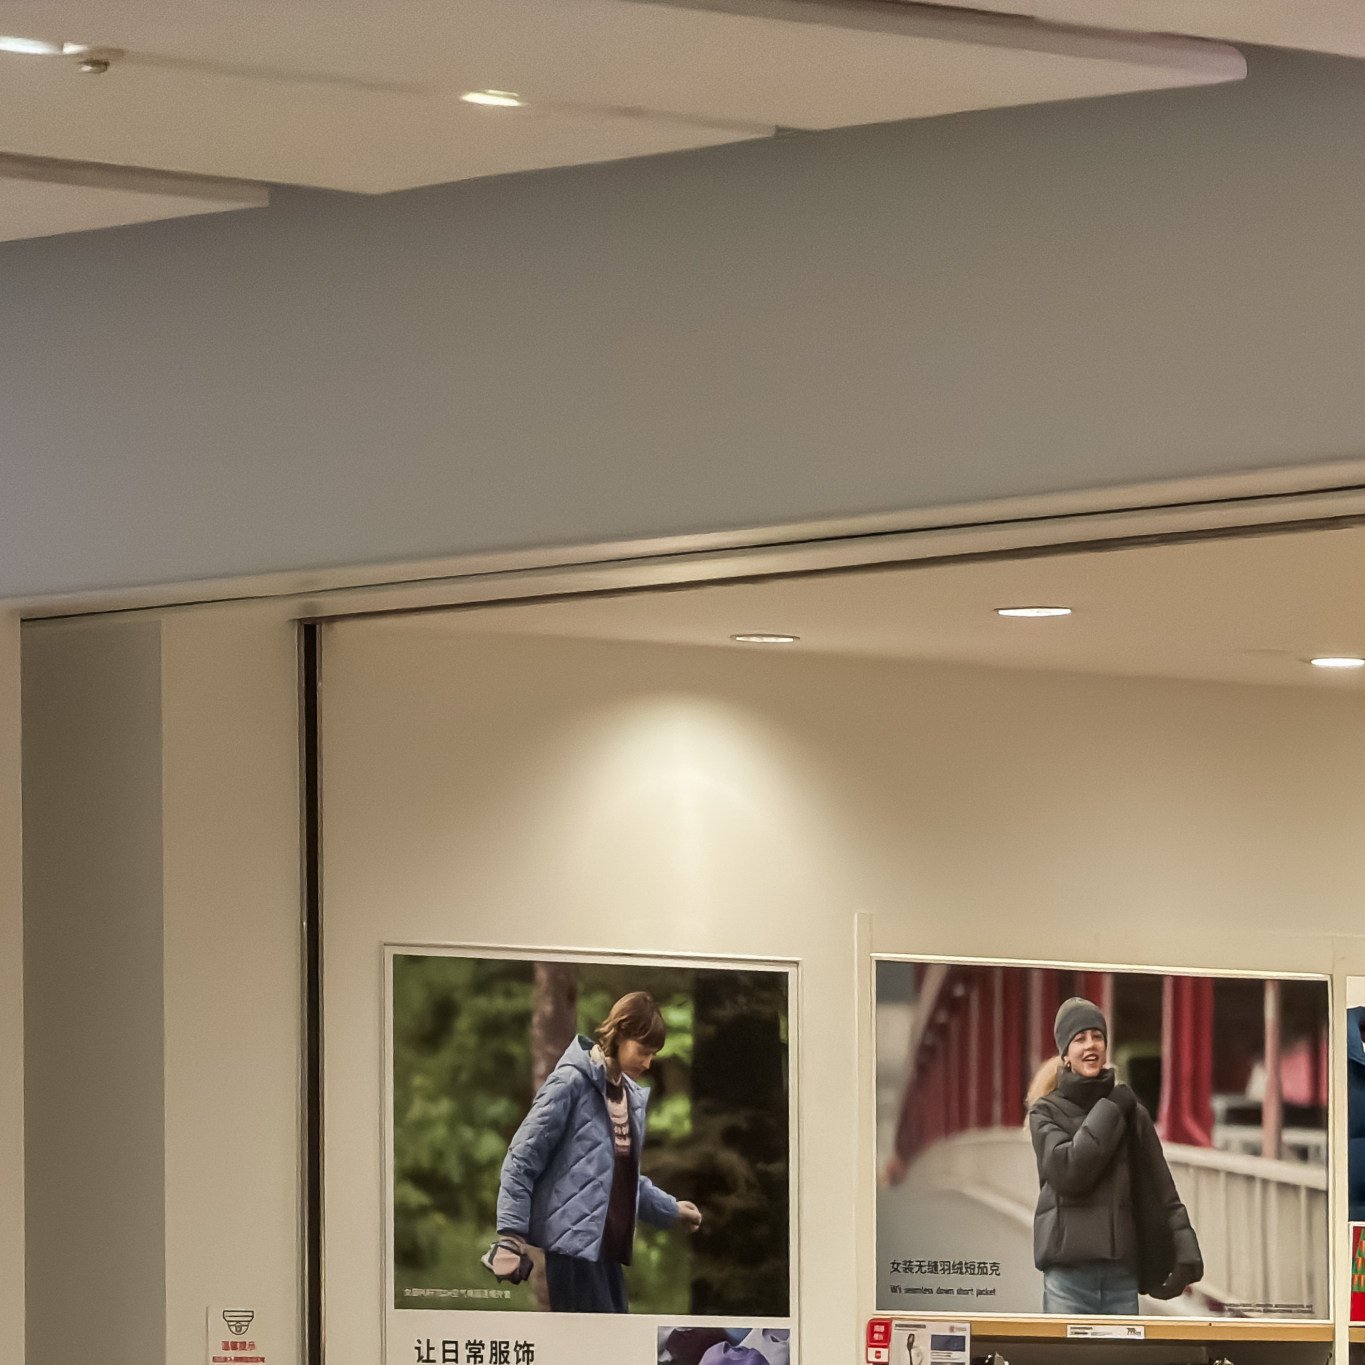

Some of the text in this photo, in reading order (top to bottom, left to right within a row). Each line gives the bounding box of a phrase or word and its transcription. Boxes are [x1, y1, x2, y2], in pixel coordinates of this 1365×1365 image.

[414, 1338, 536, 1365] 让日常服饰
